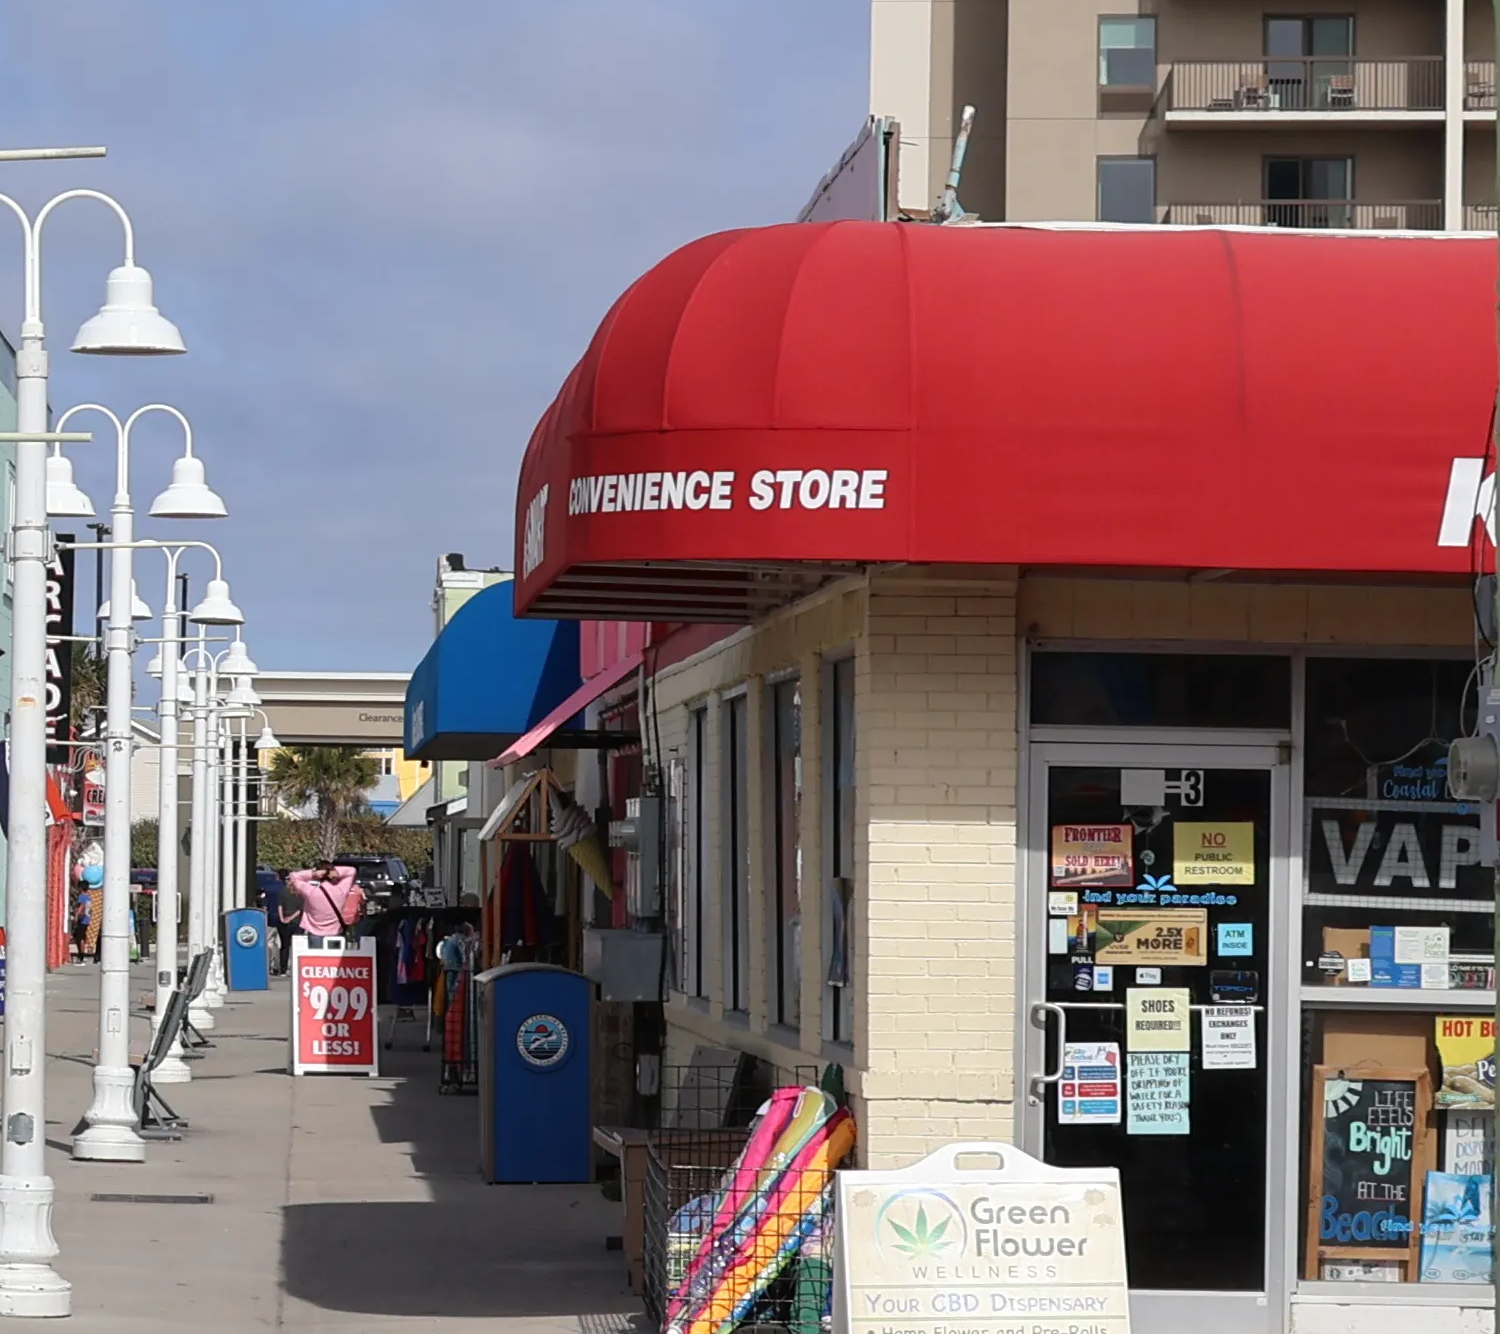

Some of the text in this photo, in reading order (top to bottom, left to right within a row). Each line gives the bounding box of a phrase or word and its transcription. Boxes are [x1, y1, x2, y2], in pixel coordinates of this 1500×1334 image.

[568, 470, 888, 515] CONVENIENCE STORE
[359, 713, 403, 723] Clearance
[1383, 779, 1439, 799] Coastal
[1064, 827, 1123, 843] FRONTIER
[1201, 832, 1226, 846] NO
[1065, 855, 1089, 867] SOLD
[1194, 853, 1233, 862] PUBLIC
[1184, 866, 1244, 875] RESTROOM
[1082, 889, 1112, 904] ind
[1160, 892, 1238, 905] paradise
[1155, 927, 1184, 938] 2.5X
[1225, 930, 1245, 938] ATM
[1136, 938, 1184, 951] MORE
[1071, 956, 1094, 964] PULL
[301, 966, 369, 979] CLEARANCE
[303, 981, 368, 1020] $9.99
[1141, 1000, 1175, 1013] SHOES
[321, 1023, 350, 1037] OR
[1208, 1019, 1249, 1028] EXCHANGES
[1442, 1020, 1473, 1037] HOT
[1220, 1032, 1237, 1040] ONLY
[312, 1040, 360, 1055] LESS!
[1130, 1055, 1160, 1066] PLEASE
[1374, 1091, 1414, 1108] LIFE
[1368, 1108, 1414, 1125] FEELS
[1350, 1121, 1412, 1175] Bright
[1357, 1181, 1406, 1199] AT THE
[970, 1197, 1070, 1225] Green
[1320, 1195, 1408, 1241] Beach
[976, 1228, 1088, 1257] Flower
[912, 1265, 1058, 1279] WELLNESS
[931, 1293, 980, 1313] CBD
